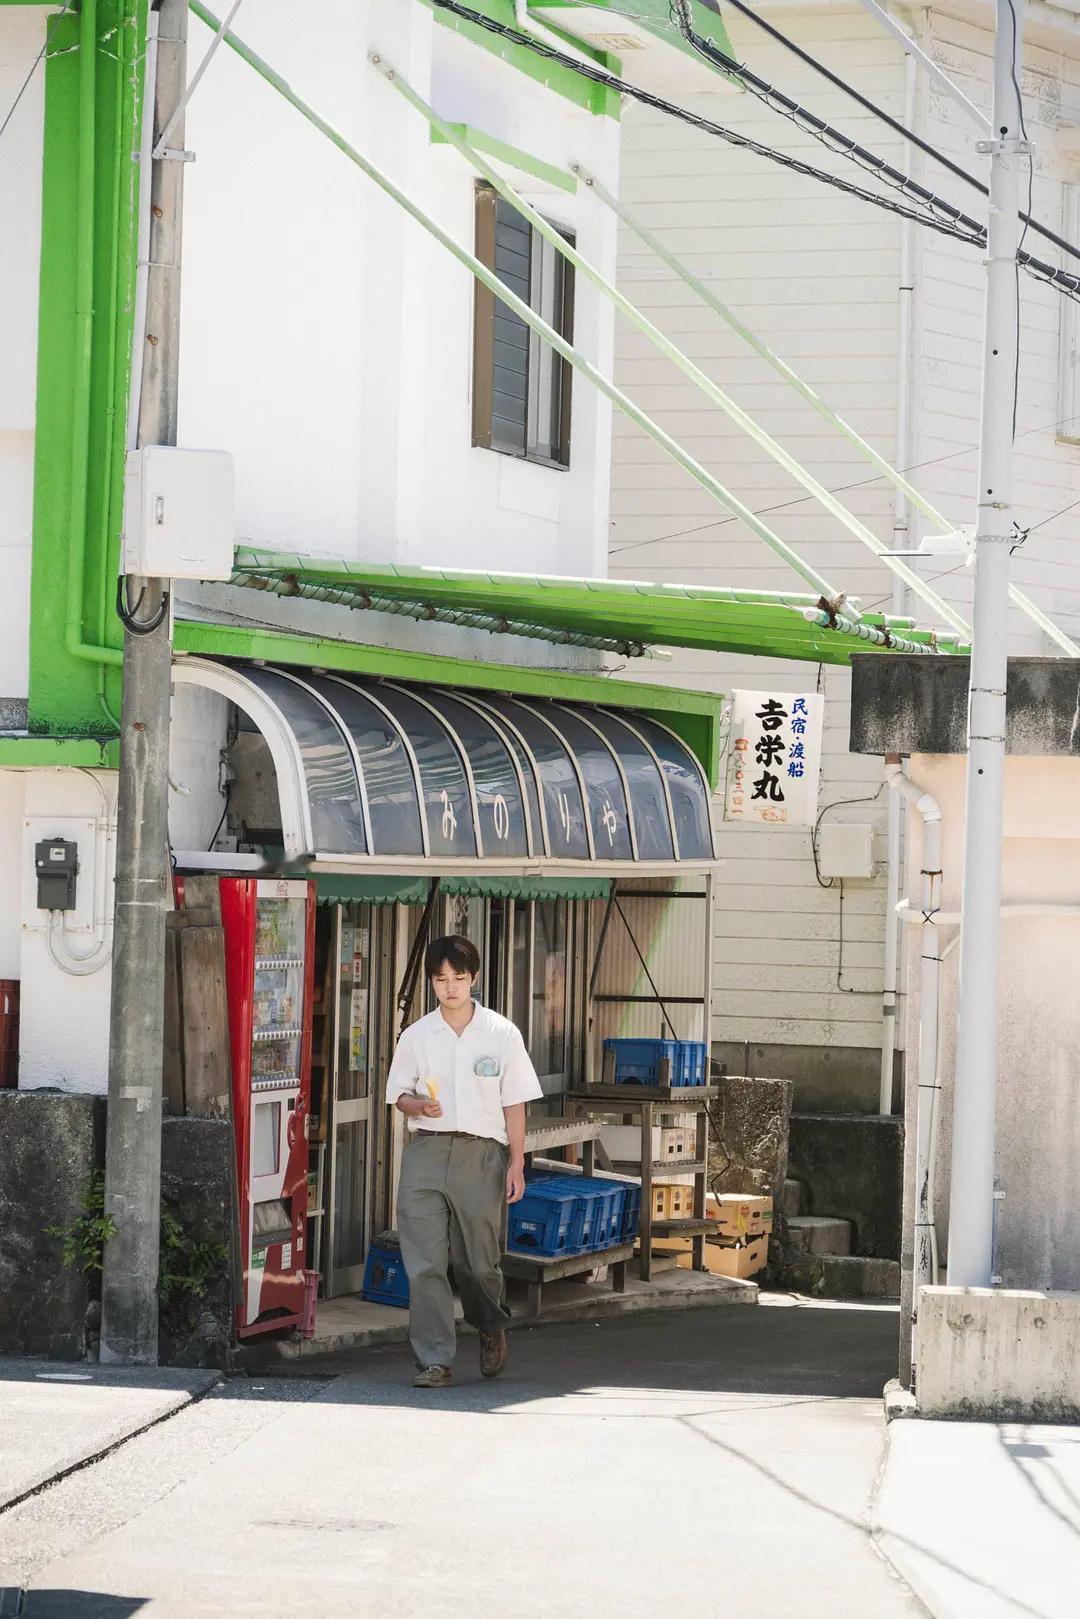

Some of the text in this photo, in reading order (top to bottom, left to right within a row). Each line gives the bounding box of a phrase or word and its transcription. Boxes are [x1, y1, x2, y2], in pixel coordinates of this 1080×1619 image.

[787, 698, 809, 778] 民宿・渡船
